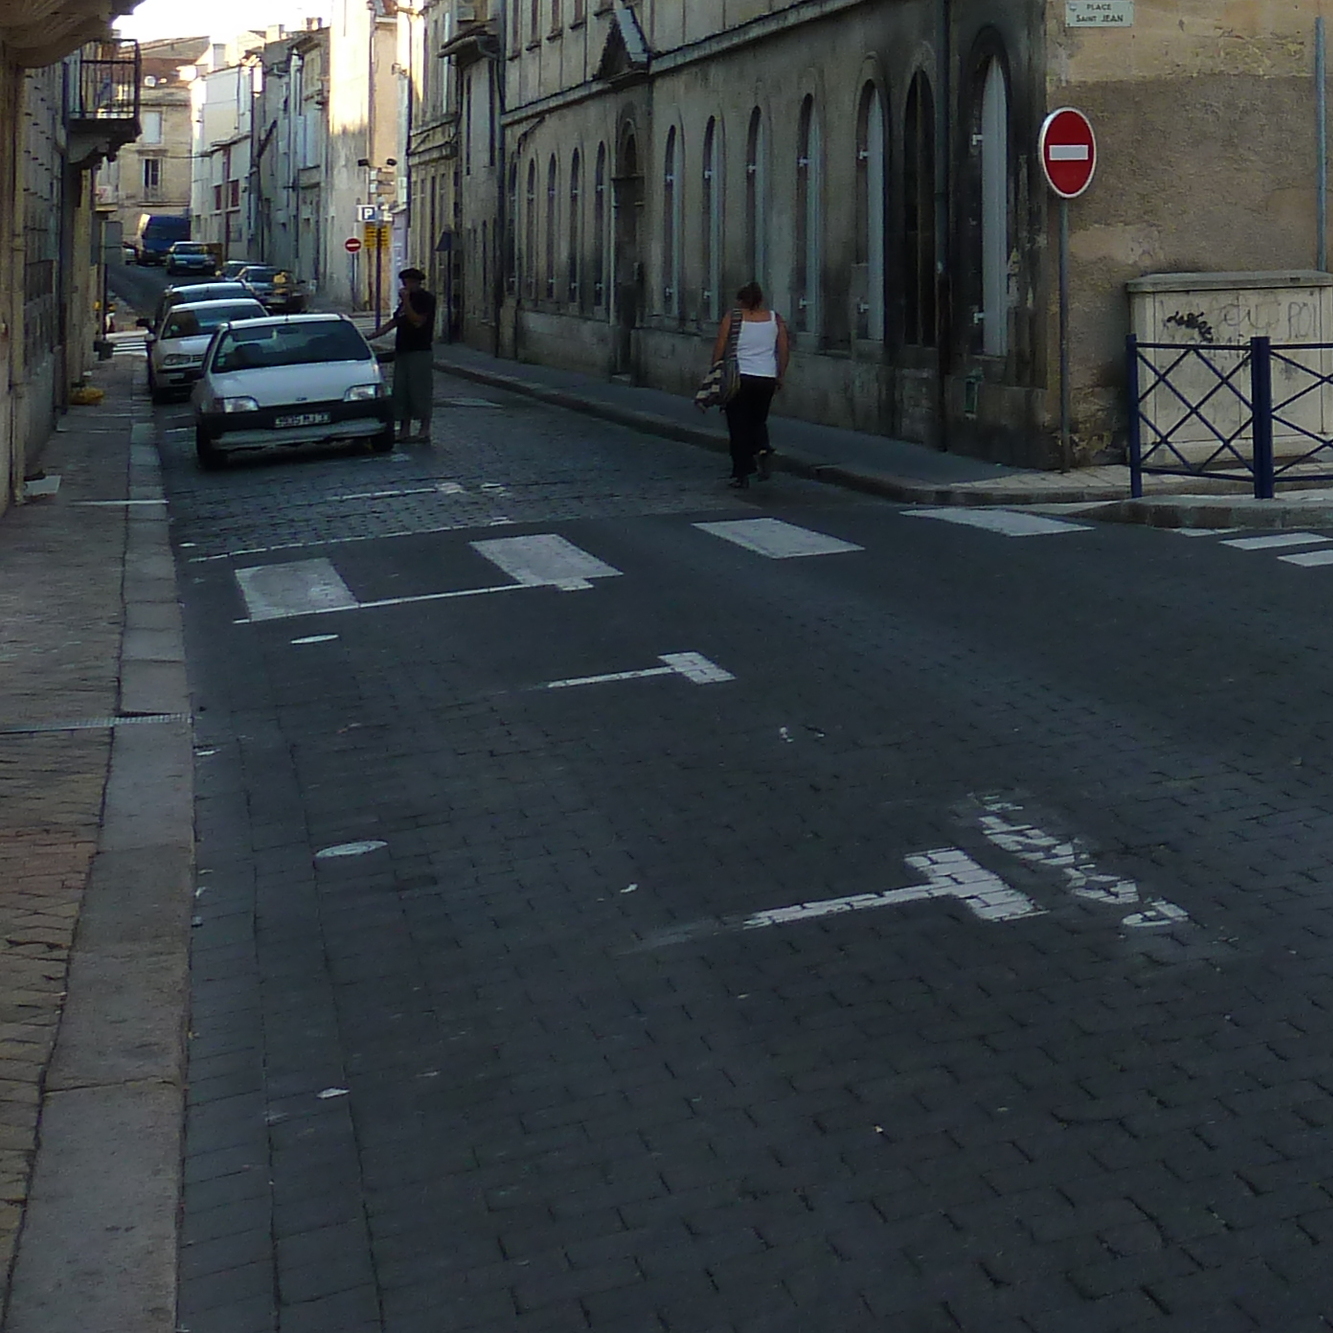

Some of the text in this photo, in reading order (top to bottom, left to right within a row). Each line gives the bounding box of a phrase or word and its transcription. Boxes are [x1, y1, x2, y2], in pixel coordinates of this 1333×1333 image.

[1086, 3, 1112, 11] PLACE
[1076, 14, 1124, 23] SAINT JEAN
[364, 207, 374, 220] P
